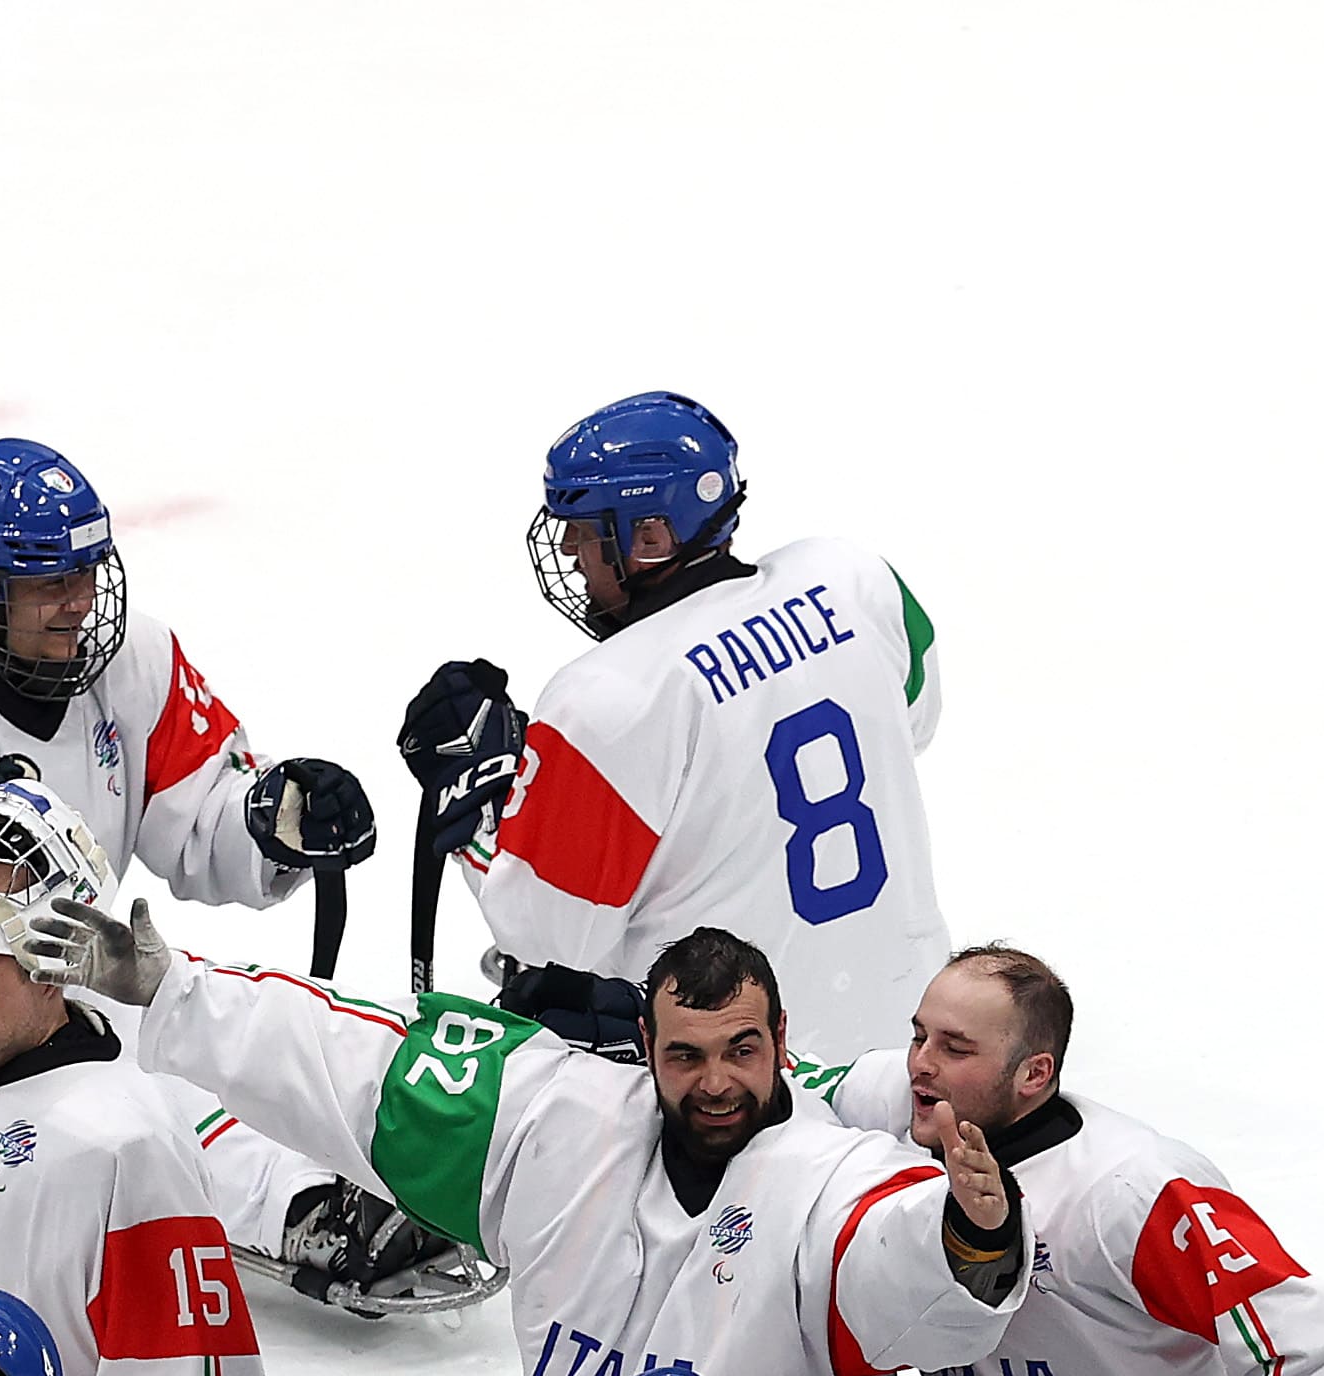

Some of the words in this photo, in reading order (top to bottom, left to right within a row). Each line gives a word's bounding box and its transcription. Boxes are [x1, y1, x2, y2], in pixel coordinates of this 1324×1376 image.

[620, 485, 656, 497] CCM
[685, 584, 855, 705] RADICE
[764, 697, 889, 927] 8
[710, 1226, 753, 1240] ITALIA
[167, 1246, 232, 1328] 15
